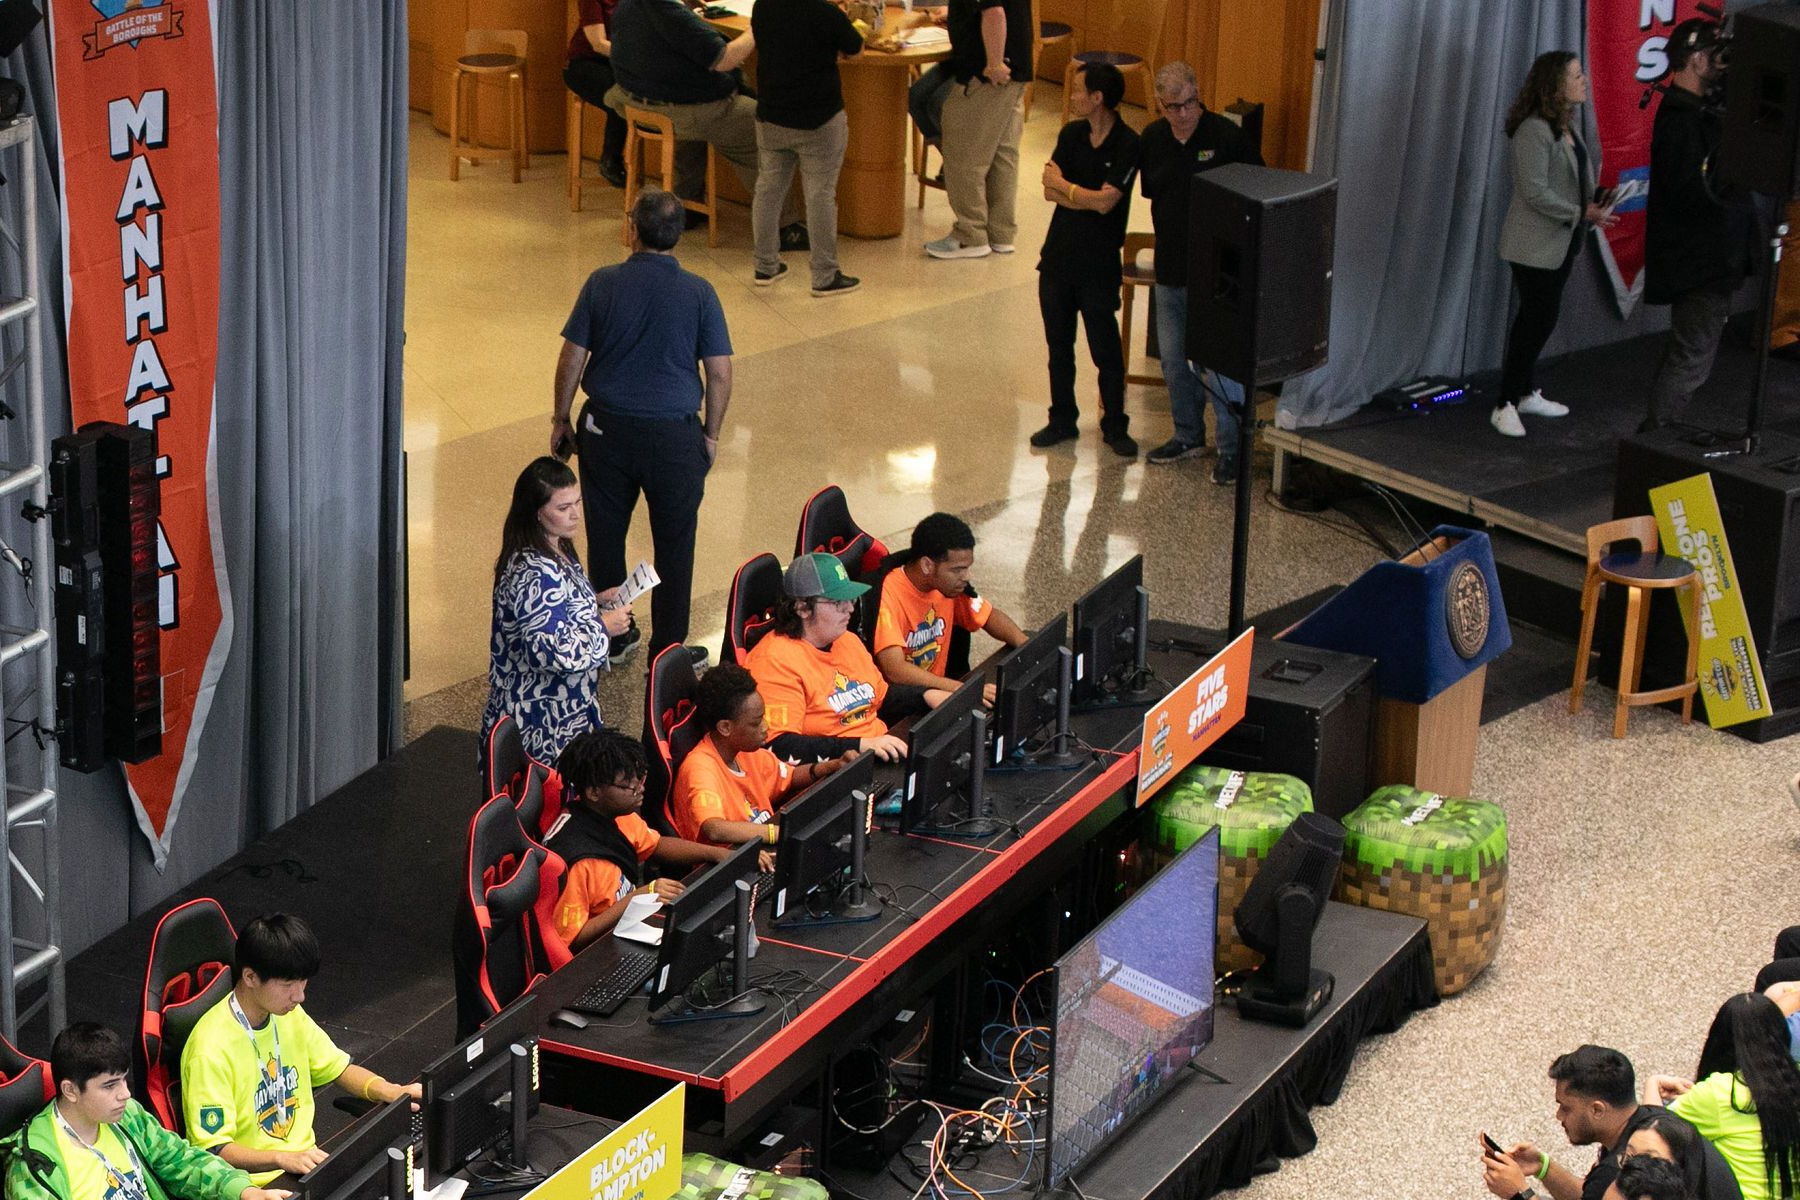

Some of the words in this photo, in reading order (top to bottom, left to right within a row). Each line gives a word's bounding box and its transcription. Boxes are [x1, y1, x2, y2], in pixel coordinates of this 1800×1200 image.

[106, 17, 135, 35] BATTLE
[136, 15, 147, 25] OF
[148, 12, 163, 22] THE
[113, 24, 157, 43] BOROUGHS
[1693, 529, 1723, 602] PROS
[1196, 664, 1225, 705] FIVE
[1187, 685, 1228, 734] STARS
[590, 1128, 656, 1191] BLOCK-
